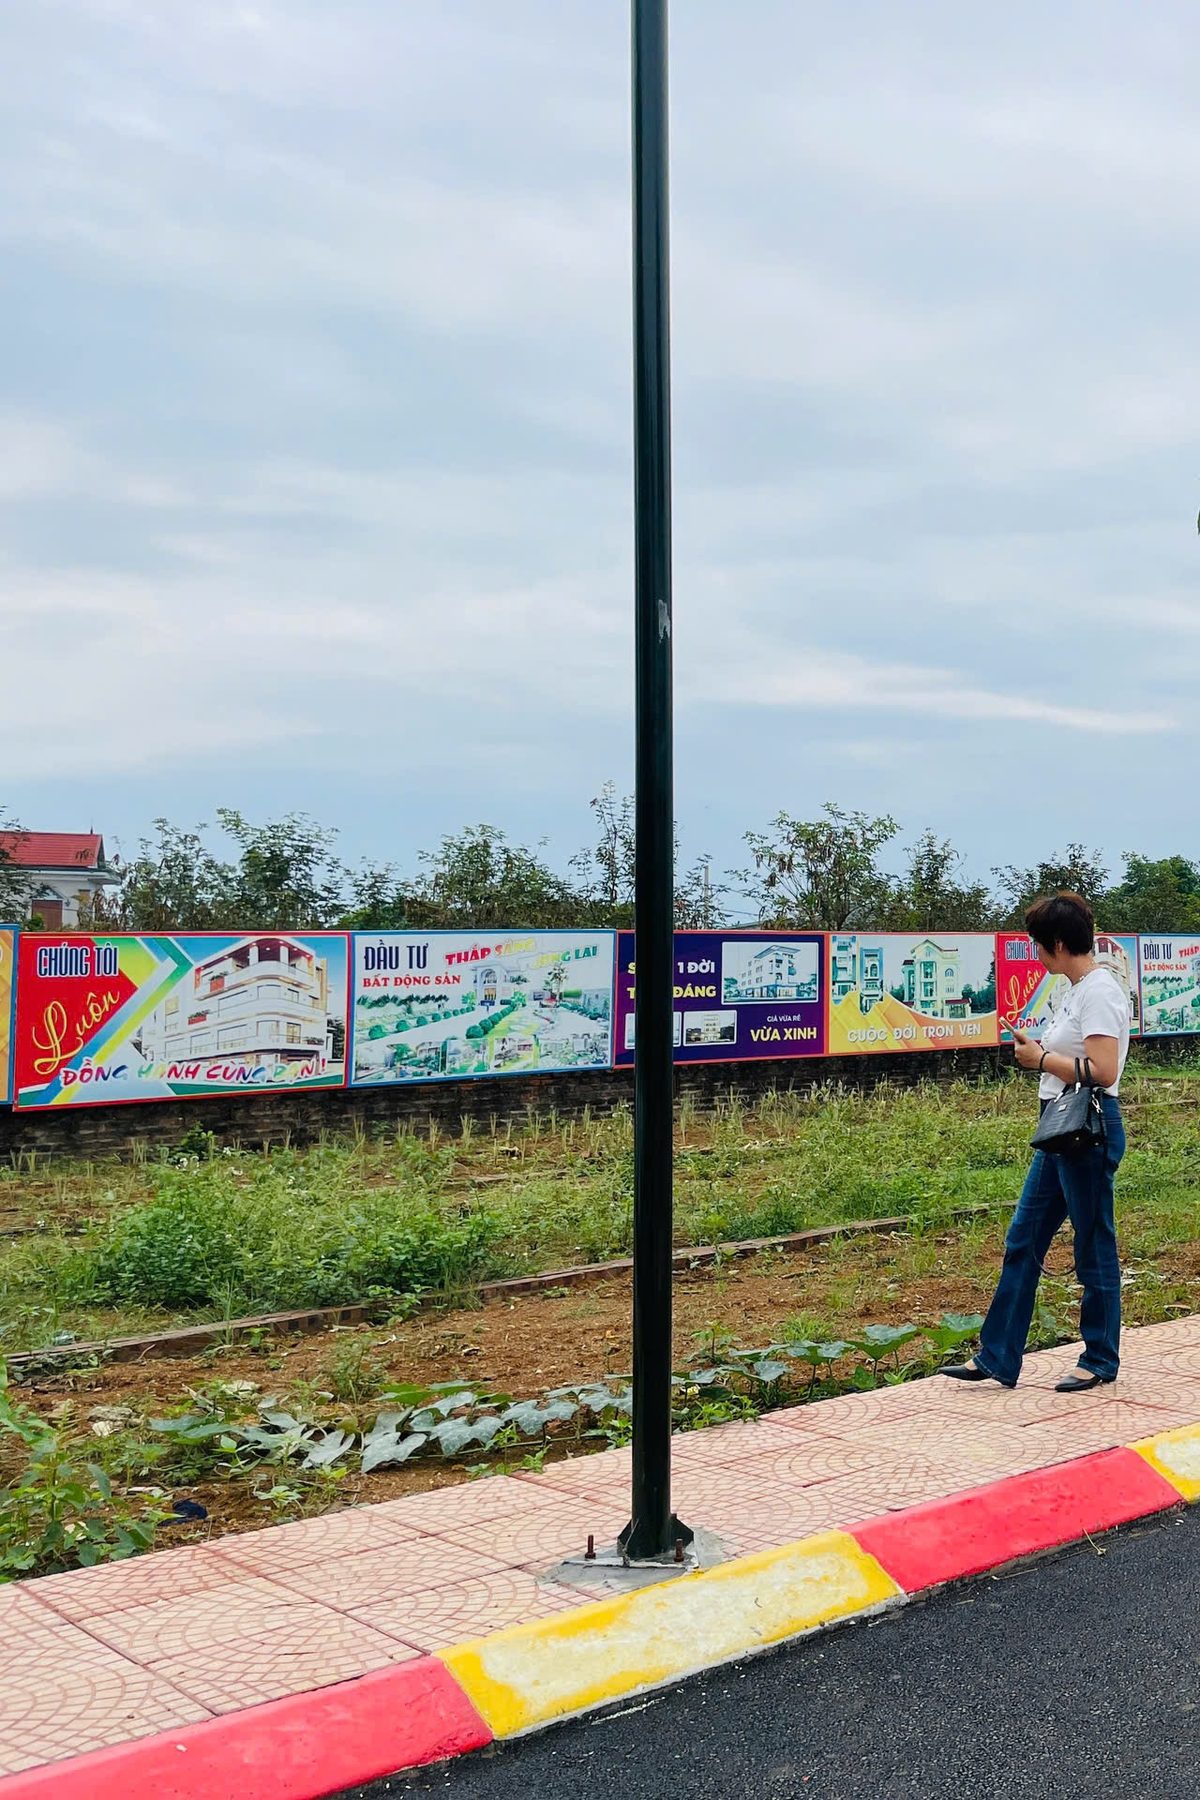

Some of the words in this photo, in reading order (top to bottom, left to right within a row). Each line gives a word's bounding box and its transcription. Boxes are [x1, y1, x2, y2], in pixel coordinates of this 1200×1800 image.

[37, 942, 90, 976] CHÚNG
[95, 943, 118, 976] TÔI
[364, 939, 400, 970] ĐẦU
[407, 943, 429, 969] TƯ
[574, 945, 598, 960] LAI
[677, 962, 684, 974] 1
[687, 959, 715, 974] ĐỜI
[363, 973, 390, 988] BẤT
[394, 974, 431, 989] ĐỘNG
[435, 971, 461, 986] SẢN
[672, 982, 716, 998] ĐÁNG
[1004, 969, 1042, 1022] Luôn
[32, 990, 120, 1075] Luôn
[750, 1025, 781, 1042] VỪA
[783, 1026, 817, 1041] XINH
[847, 1025, 888, 1045] CUỘC
[922, 1024, 954, 1041] TRỌN
[959, 1023, 981, 1040] VẸN
[61, 1057, 128, 1086] ĐỒNG
